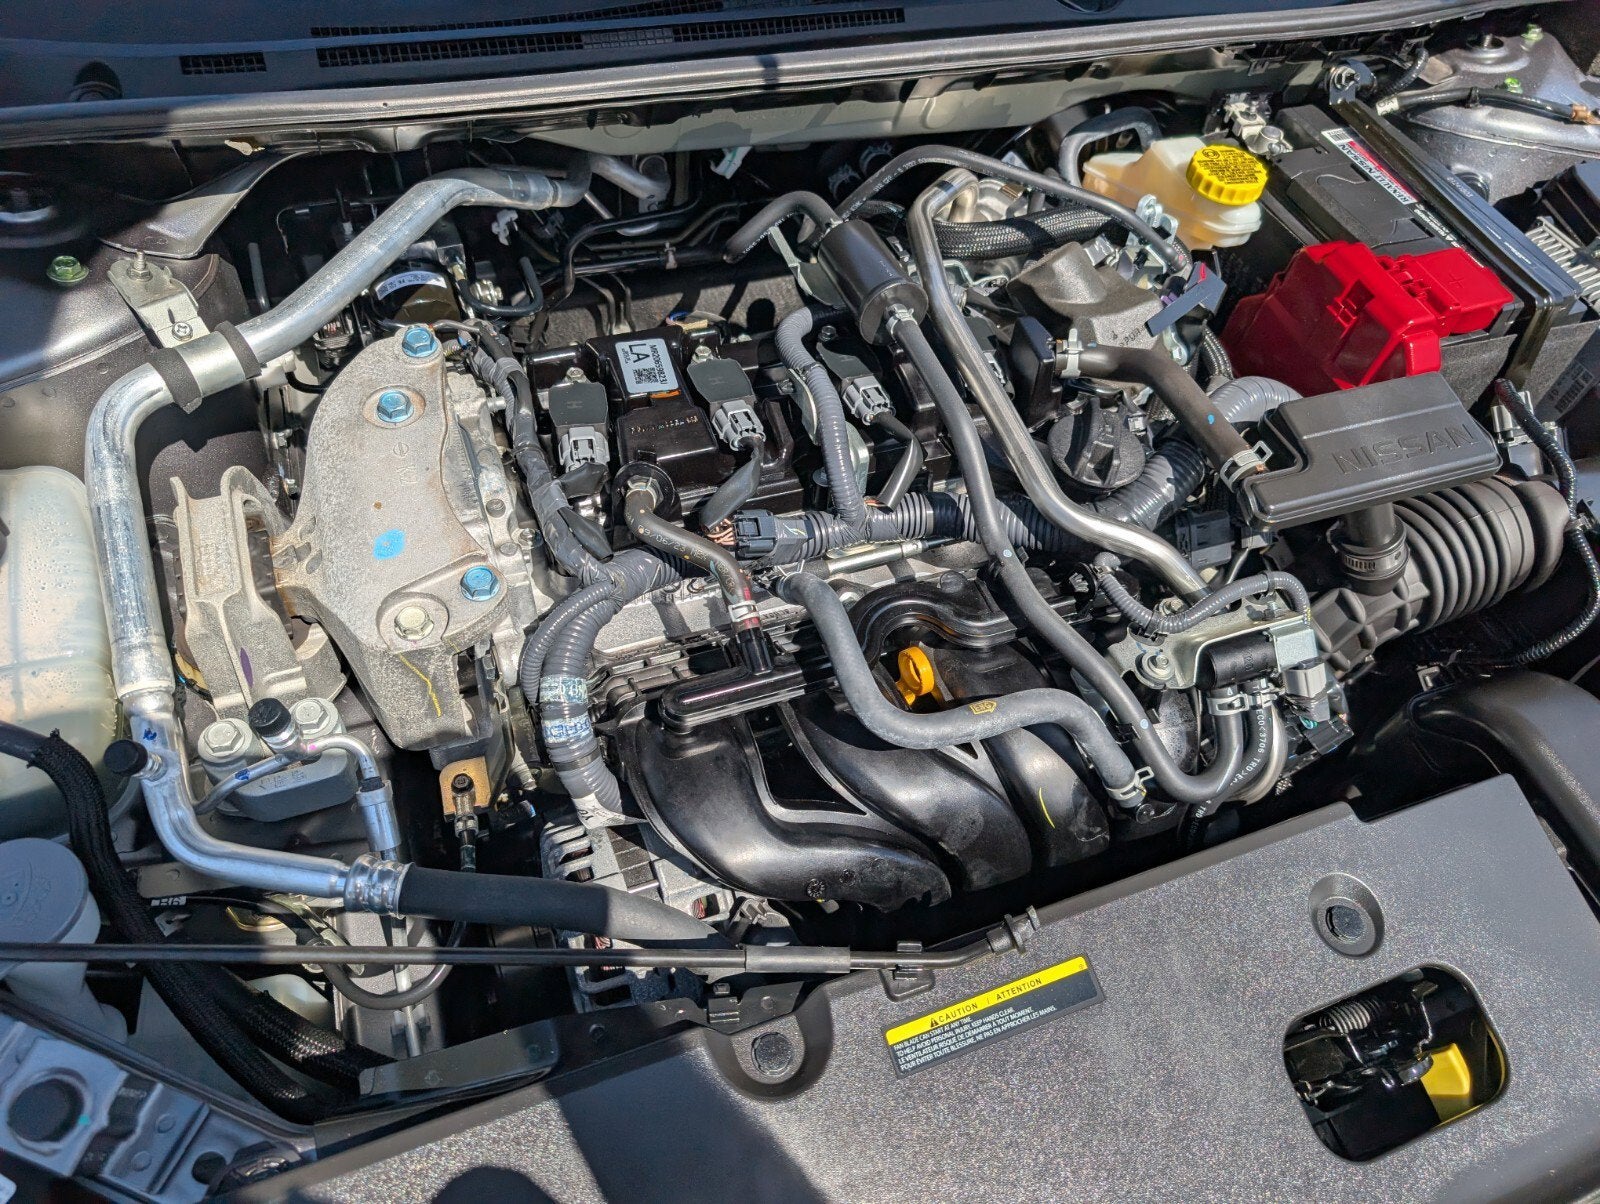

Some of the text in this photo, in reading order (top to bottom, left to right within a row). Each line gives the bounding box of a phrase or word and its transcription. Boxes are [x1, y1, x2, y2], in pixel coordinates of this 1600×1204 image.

[1340, 144, 1409, 202] RENAULT NISSAN
[629, 343, 650, 363] LA
[1332, 423, 1477, 475] NISSAN
[938, 1003, 978, 1023] CAUTION
[996, 978, 1042, 1001] ATTENTION
[901, 1060, 916, 1070] POUR
[933, 1047, 951, 1057] TOUTE
[983, 1030, 993, 1038] PAS
[1000, 1015, 1030, 1031] APPROCHER
[1030, 1011, 1039, 1019] LES
[903, 1037, 919, 1047] BLADE
[919, 1033, 930, 1041] CAN
[930, 1027, 944, 1036] START
[904, 1046, 916, 1054] HELP
[916, 1040, 931, 1049] AVOID
[931, 1030, 955, 1043] PERSONAL
[972, 1019, 983, 1027] KEEP
[983, 1013, 999, 1023] HANDS
[905, 1044, 939, 1061] VENTILATEUR
[939, 1037, 957, 1048] RISQUE
[997, 1016, 1010, 1025] TOUT
